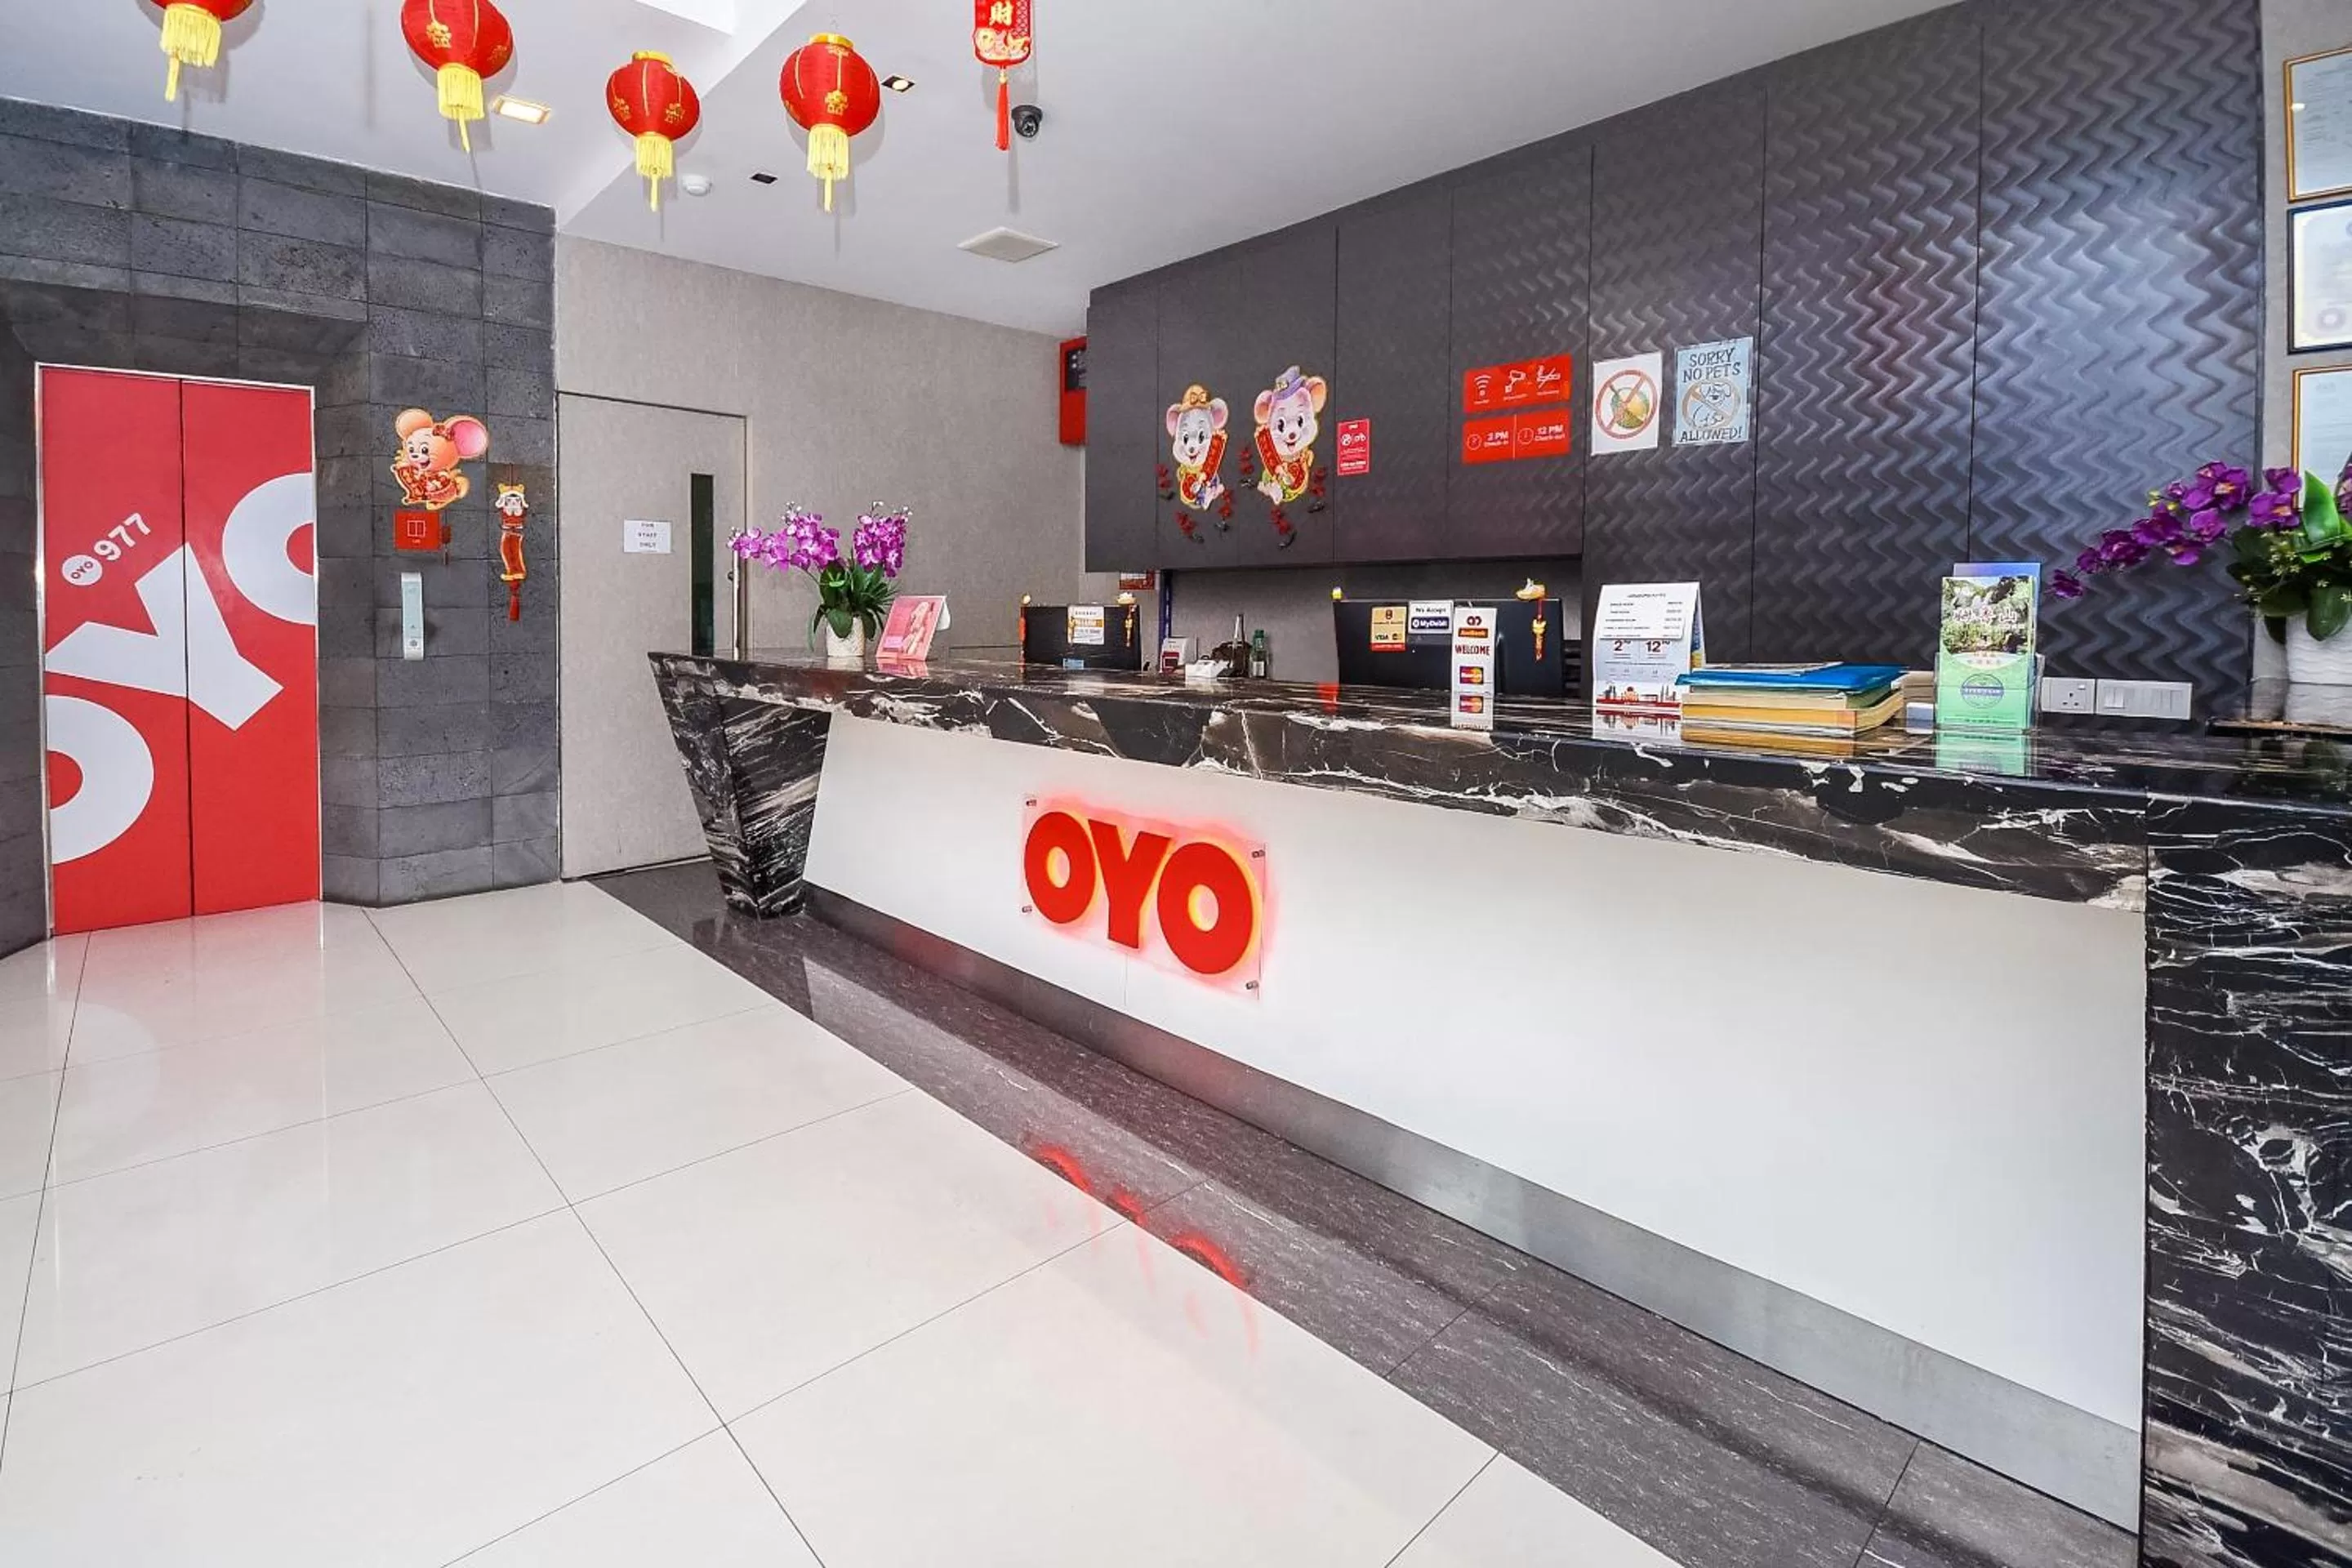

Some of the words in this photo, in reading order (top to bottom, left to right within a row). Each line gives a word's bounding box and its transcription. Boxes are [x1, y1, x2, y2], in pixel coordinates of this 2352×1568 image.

[1690, 348, 1735, 368] SORRY
[1682, 368, 1702, 383] NO
[1704, 362, 1741, 380] PETS
[1680, 426, 1743, 442] ALLOWED!
[70, 561, 94, 580] OYO
[93, 512, 152, 561] 977
[1454, 644, 1490, 656] WELCOME
[1024, 811, 1254, 974] OYO
